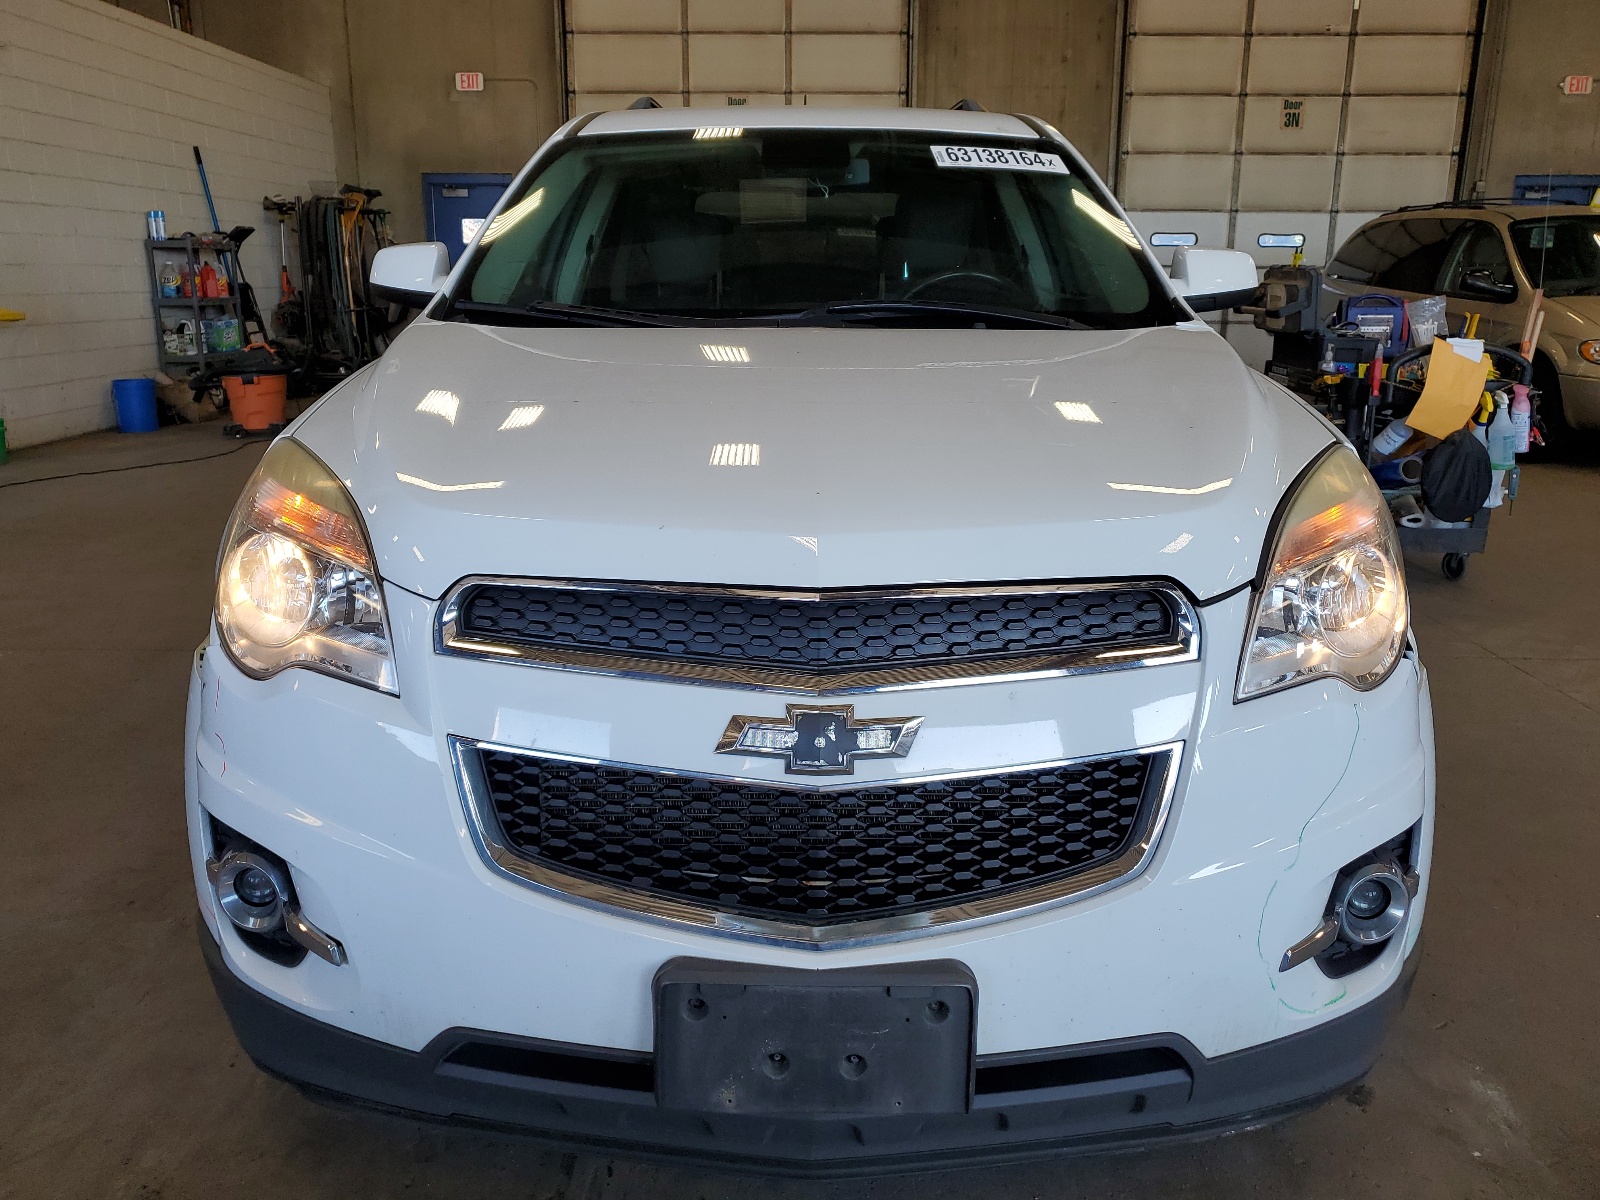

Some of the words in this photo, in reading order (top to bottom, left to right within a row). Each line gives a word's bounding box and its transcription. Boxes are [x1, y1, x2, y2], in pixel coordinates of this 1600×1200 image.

[460, 73, 479, 89] EXIT
[1569, 75, 1589, 92] EXIT
[727, 96, 747, 106] Door
[1283, 99, 1303, 110] Door
[1284, 111, 1300, 128] 3N
